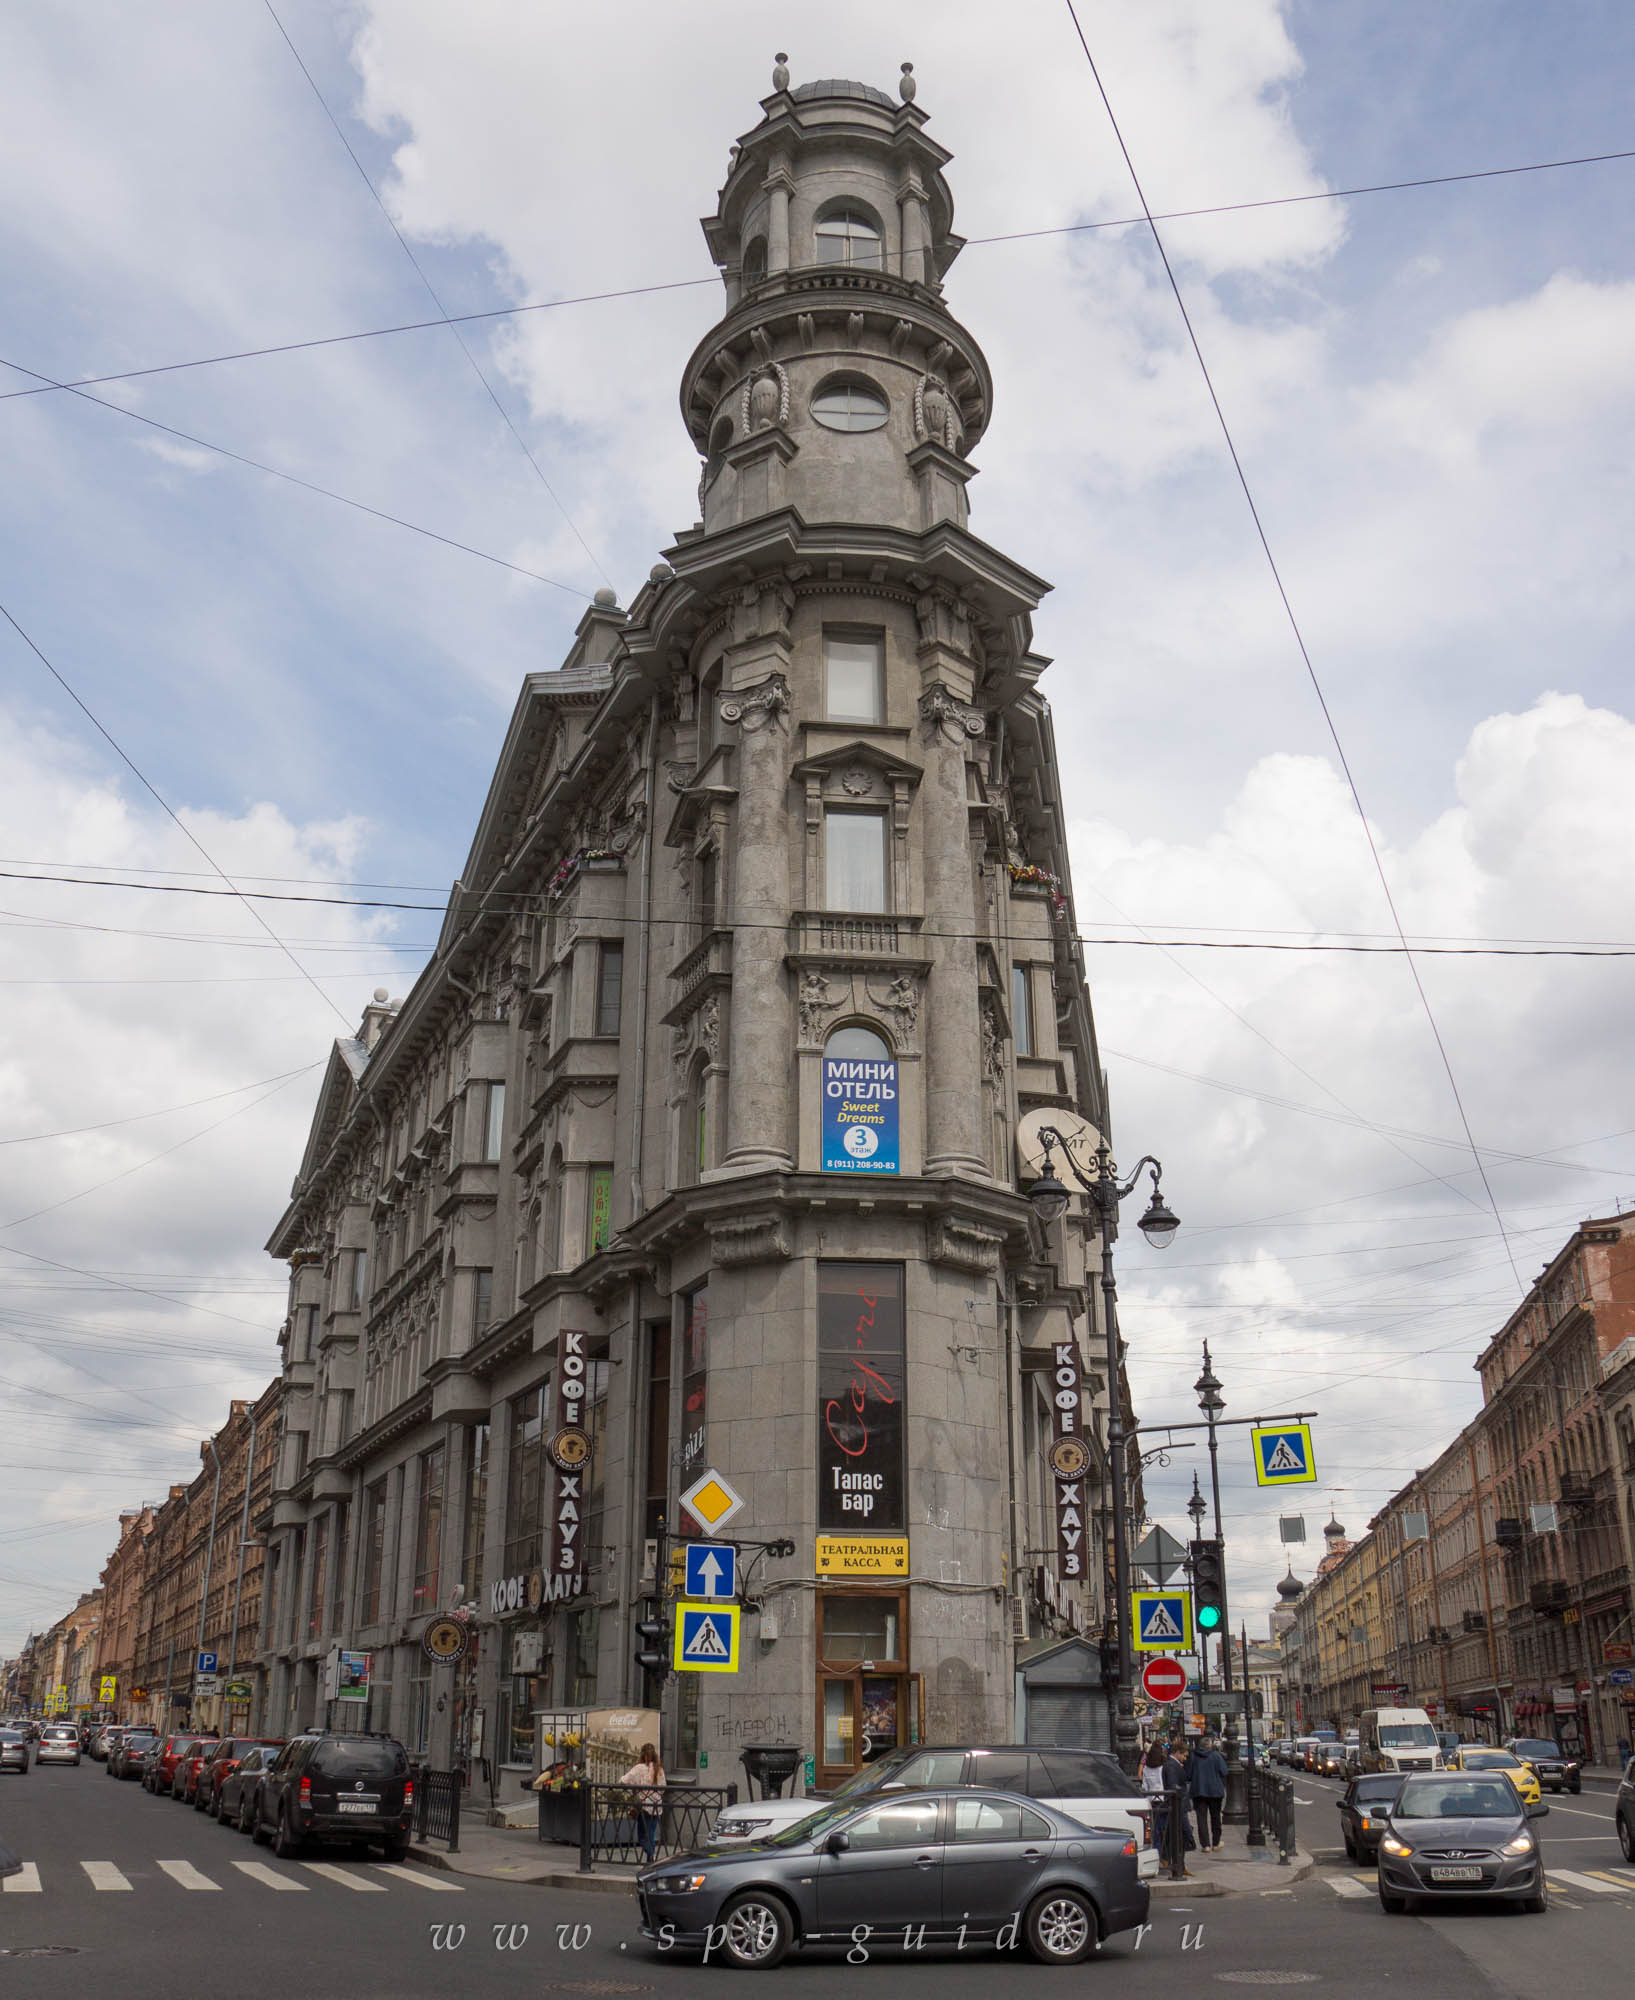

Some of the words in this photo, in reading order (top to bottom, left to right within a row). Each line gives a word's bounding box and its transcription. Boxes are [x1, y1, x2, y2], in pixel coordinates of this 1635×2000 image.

[828, 1062, 895, 1080] МИНИ
[827, 1081, 896, 1099] ОТЕЛЬ
[841, 1101, 880, 1112] Sweet
[837, 1112, 885, 1124] Dreams
[855, 1129, 867, 1145] 3
[834, 1160, 855, 1169] (911)
[856, 1161, 896, 1169] 208-90-83
[562, 1333, 585, 1423] КОФЕ
[1056, 1345, 1079, 1432] КОФЕ
[832, 1466, 884, 1490] Тапас
[558, 1476, 581, 1569] ХАУЗ
[1059, 1484, 1082, 1575] ХАУЗ
[822, 1545, 904, 1555] ТЕАТРАЛЬНАЯ
[843, 1558, 881, 1567] КАССА
[491, 1575, 524, 1614] КОФЕ
